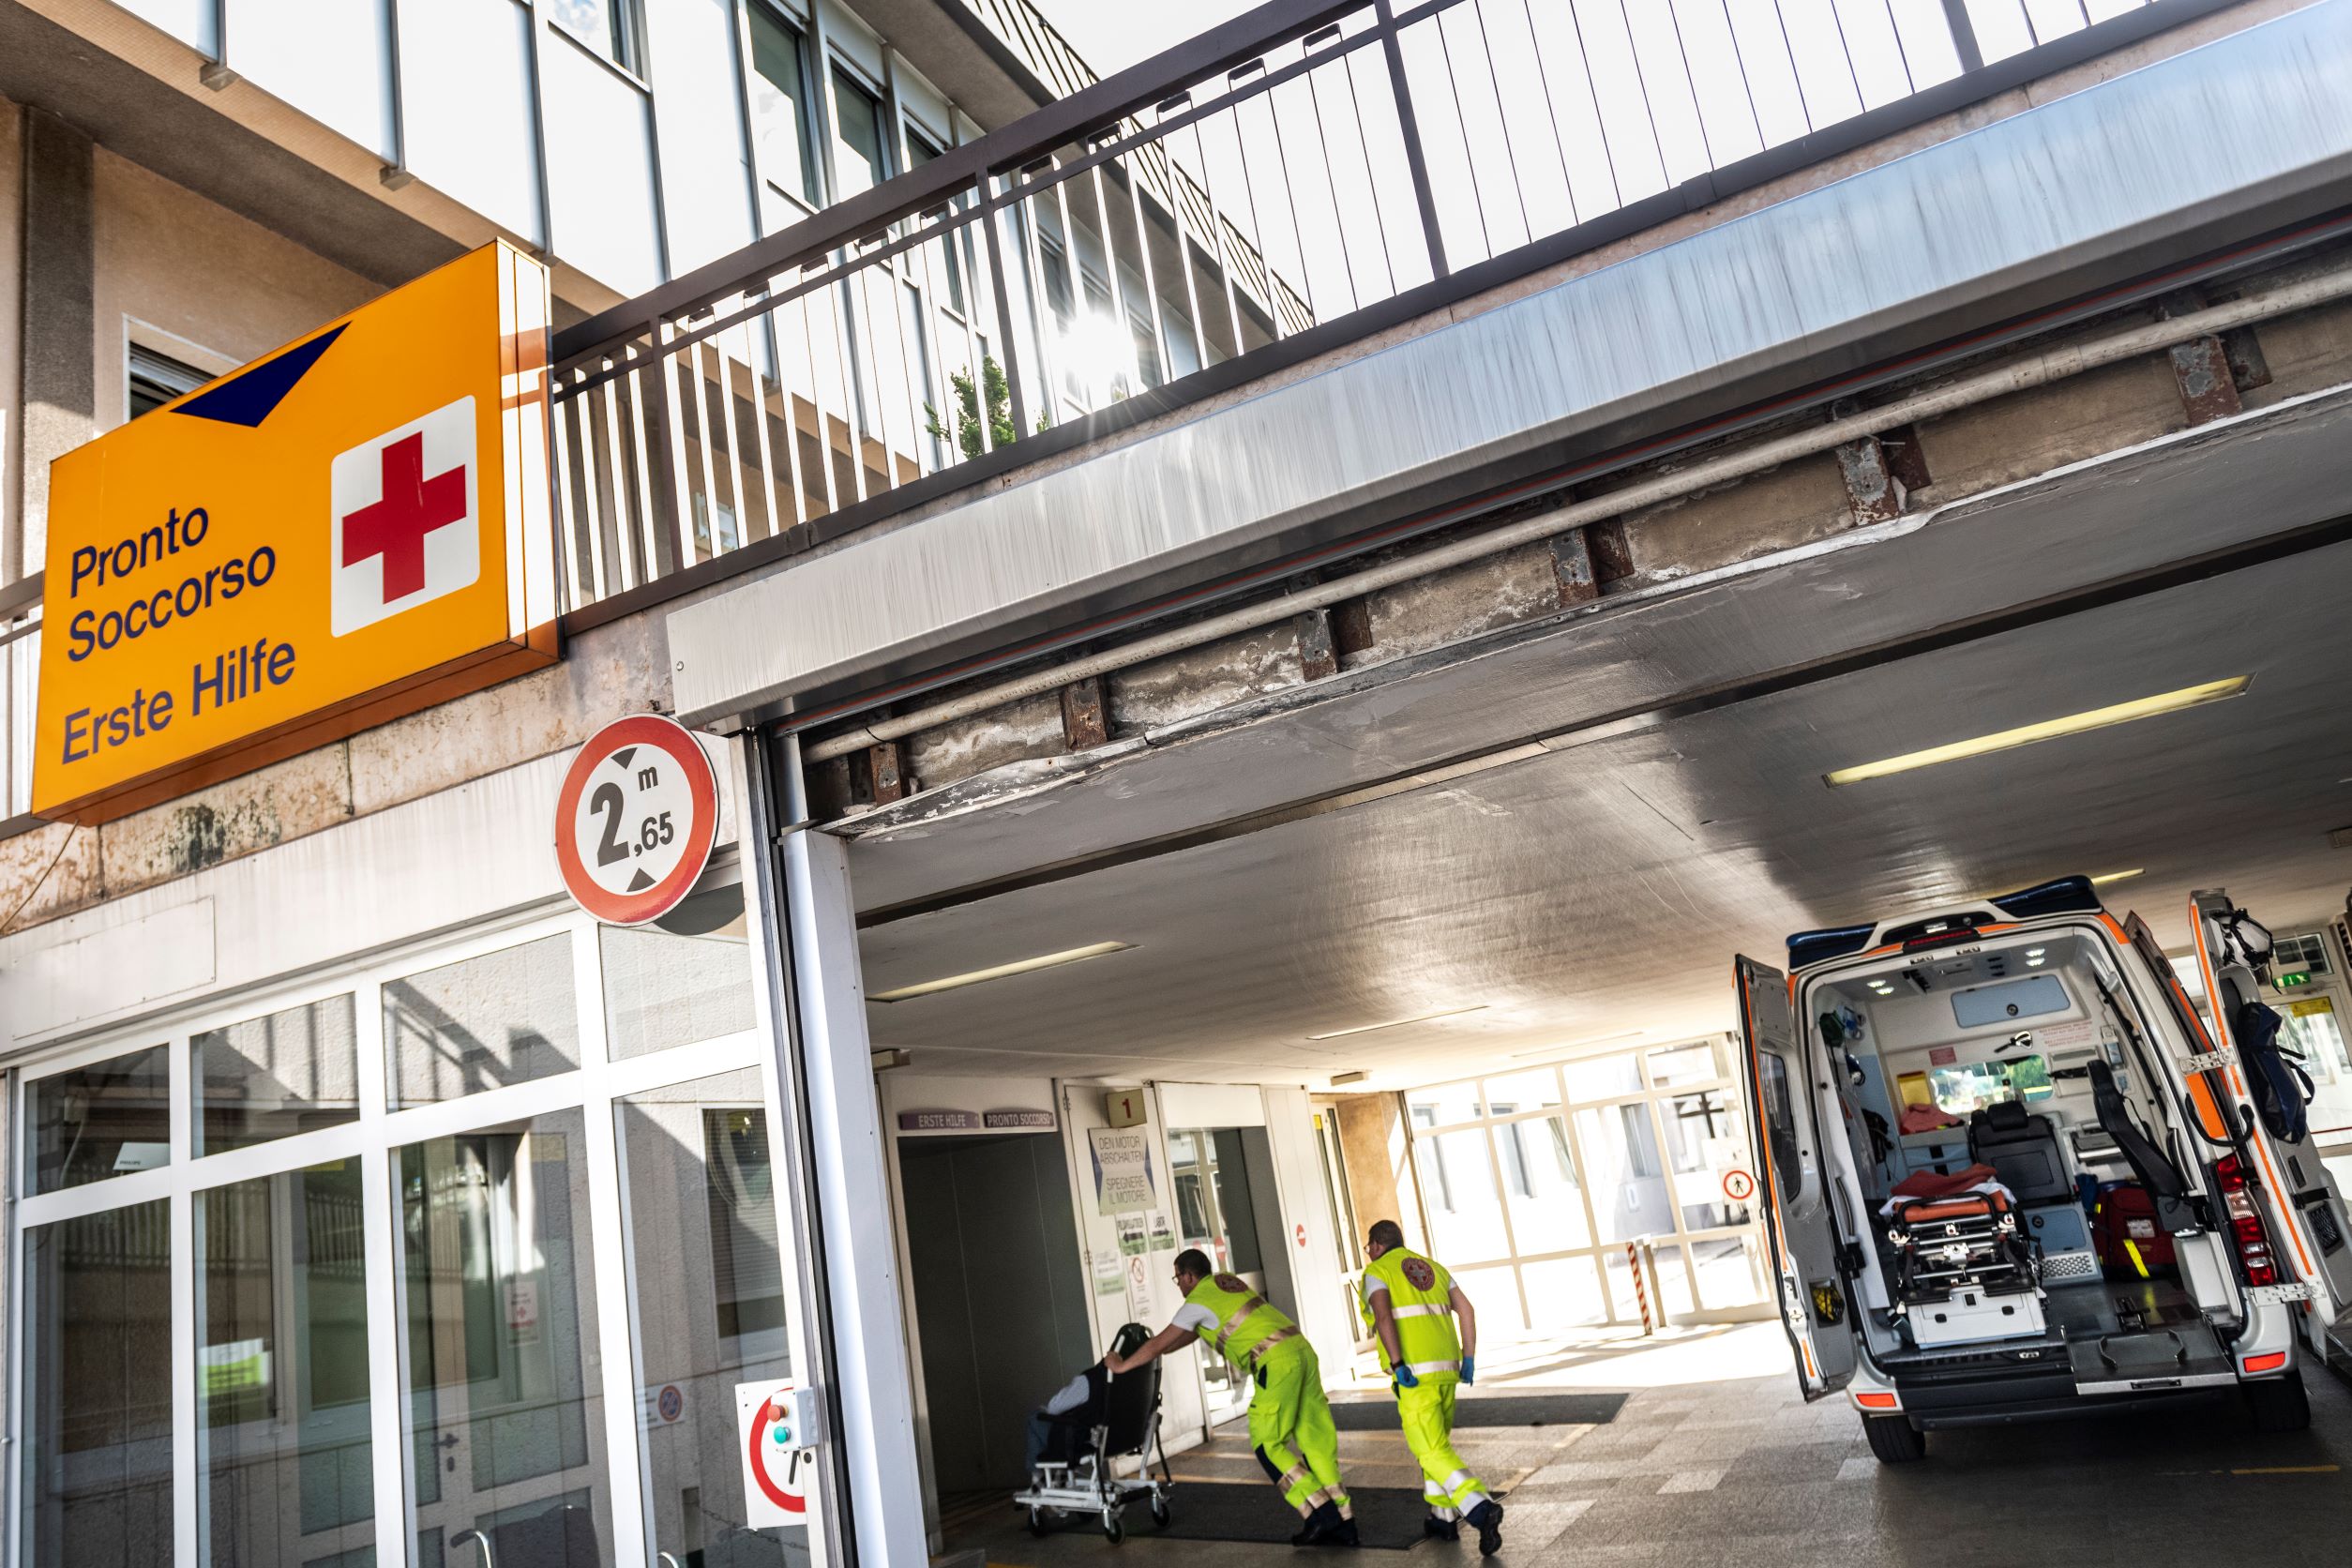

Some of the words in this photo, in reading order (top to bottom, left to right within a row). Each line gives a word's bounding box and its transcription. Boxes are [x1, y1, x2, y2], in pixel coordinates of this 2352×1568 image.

[70, 507, 208, 598] Pronto
[68, 546, 276, 662] Soccorso
[62, 688, 173, 764] Erste
[192, 638, 295, 716] Hilfe
[638, 766, 658, 792] m
[1121, 1098, 1132, 1119] 1
[918, 1114, 944, 1127] ERSTE
[945, 1114, 966, 1127] HILFE
[987, 1113, 1019, 1127] PRONTO
[1020, 1112, 1051, 1125] SOCCORSO
[1098, 1137, 1114, 1150] DEN
[1115, 1136, 1140, 1149] MOTOR
[1100, 1150, 1145, 1165] ABSCHALTEN
[1106, 1175, 1145, 1190] SPEGNERE
[1116, 1188, 1147, 1204] MOTORE
